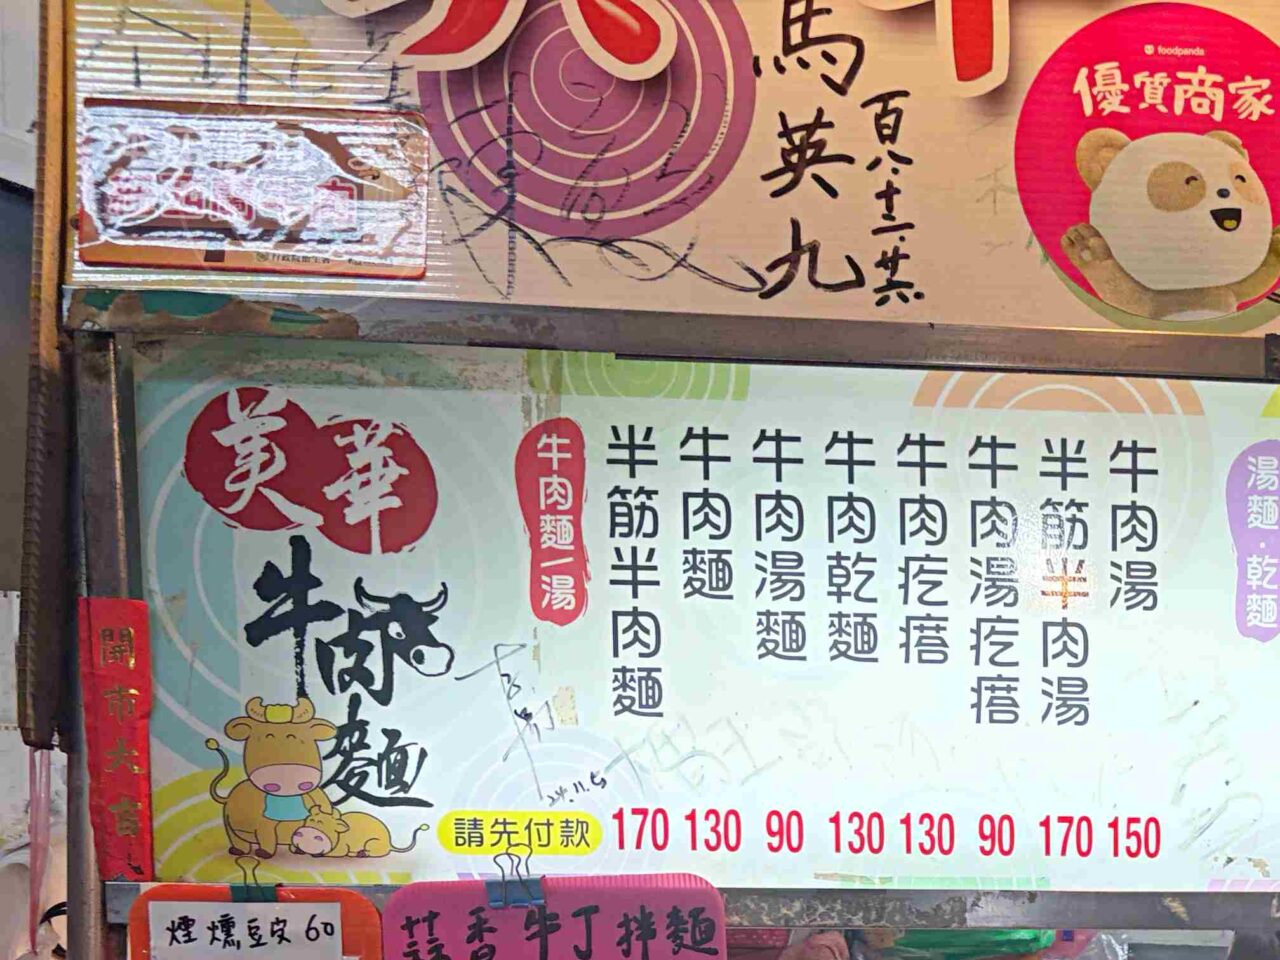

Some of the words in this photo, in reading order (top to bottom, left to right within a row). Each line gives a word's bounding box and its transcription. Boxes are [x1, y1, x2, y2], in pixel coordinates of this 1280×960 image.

[753, 0, 865, 299] 馬英九
[1073, 61, 1276, 122] 優質商家
[1157, 46, 1205, 57] foodpanda
[606, 425, 664, 717] 半筋半肉麵
[680, 427, 733, 599] 牛肉麵
[753, 429, 807, 661] 牛肉湯麵
[825, 431, 879, 662] 牛肉乾麵
[897, 433, 949, 664] 牛肉疙瘩
[969, 436, 1020, 724] 牛肉湯疙瘩
[1040, 438, 1090, 725] 半筋半肉湯
[1110, 440, 1159, 611] 牛肉湯
[305, 914, 335, 943] 60
[454, 817, 591, 849] 請先付款
[613, 808, 669, 851] 170
[685, 809, 741, 852] 130
[766, 810, 803, 853] 90
[829, 811, 884, 853] 130
[900, 813, 954, 855] 130
[978, 814, 1015, 856] 90
[1040, 816, 1093, 857] 170
[1108, 817, 1161, 858] 150
